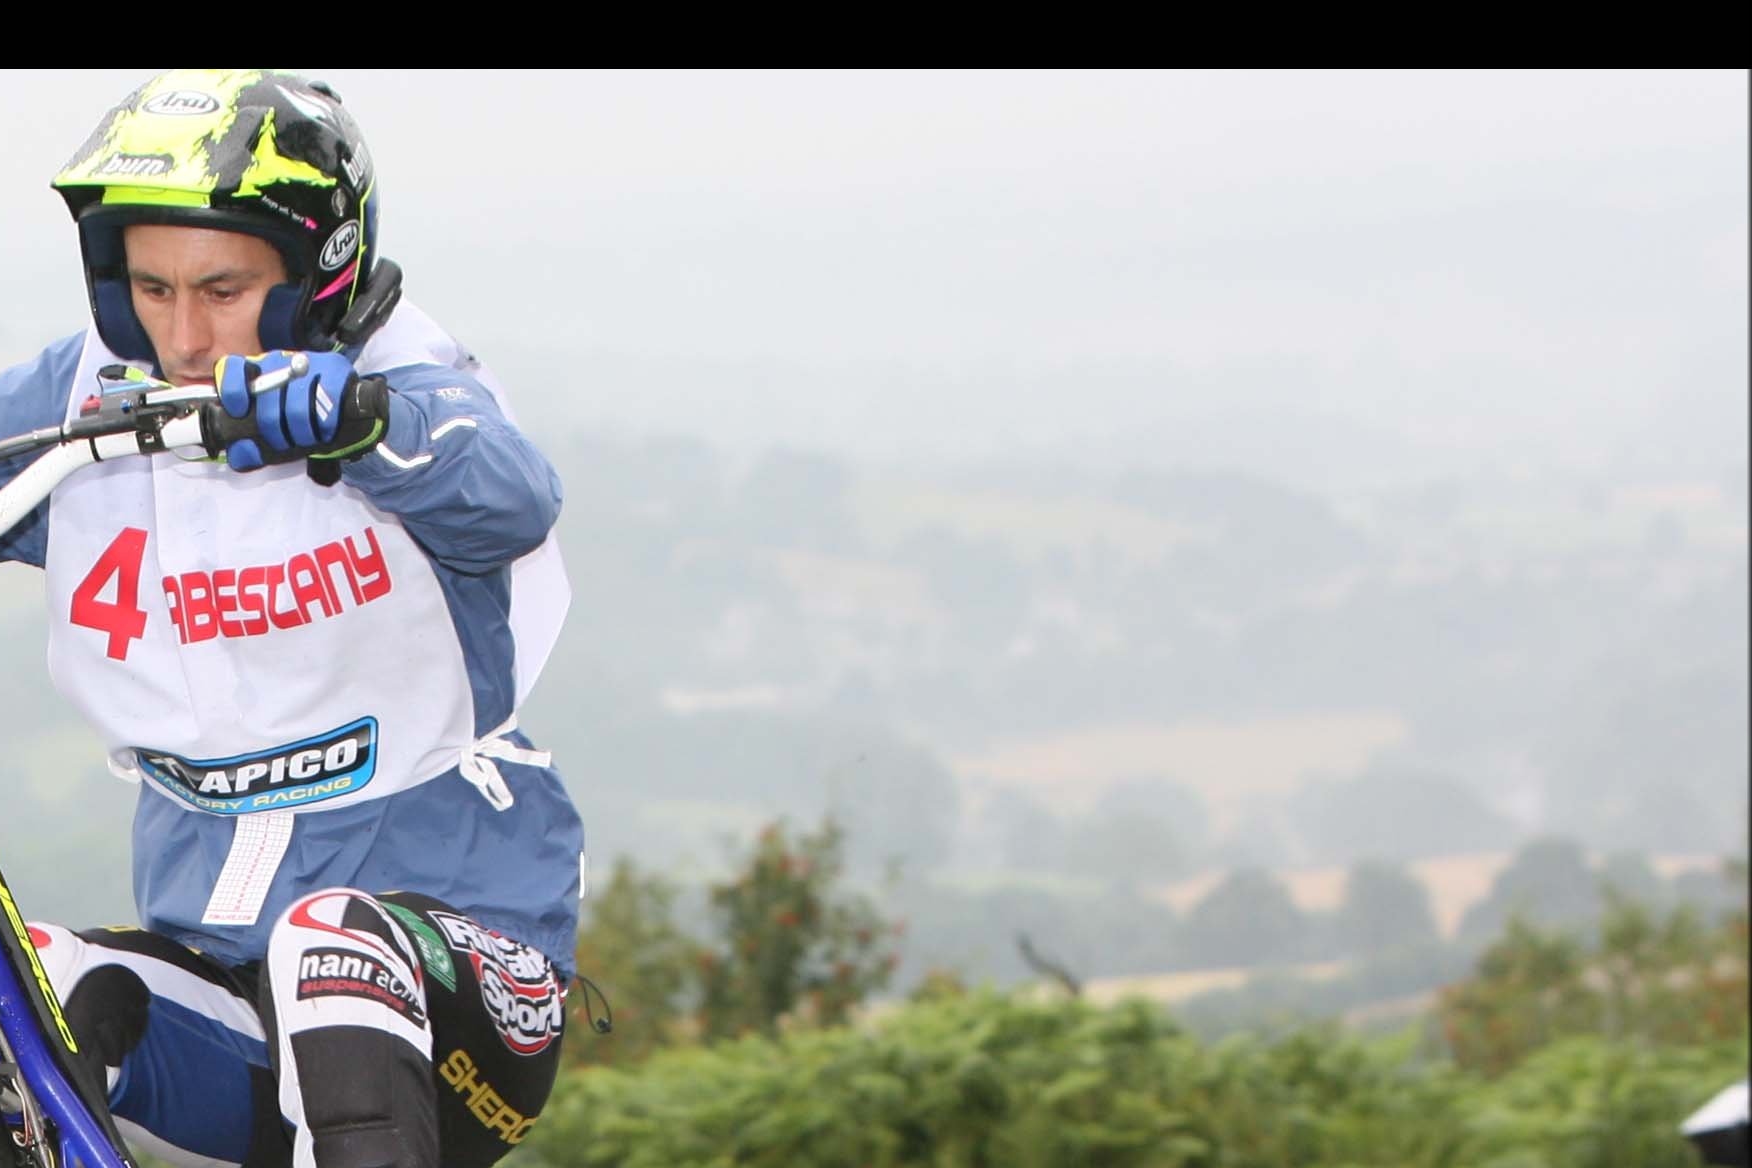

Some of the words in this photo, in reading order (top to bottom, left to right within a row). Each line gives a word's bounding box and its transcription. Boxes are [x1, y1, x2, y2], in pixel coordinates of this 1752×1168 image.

[150, 90, 210, 109] Arai
[101, 153, 167, 175] burn
[325, 225, 356, 264] Arai
[70, 527, 148, 661] 4
[162, 526, 393, 645] ABESTANY
[198, 738, 358, 794] APICO
[252, 776, 353, 807] RACING
[300, 953, 373, 982] nani
[440, 1049, 539, 1145] SHERC
